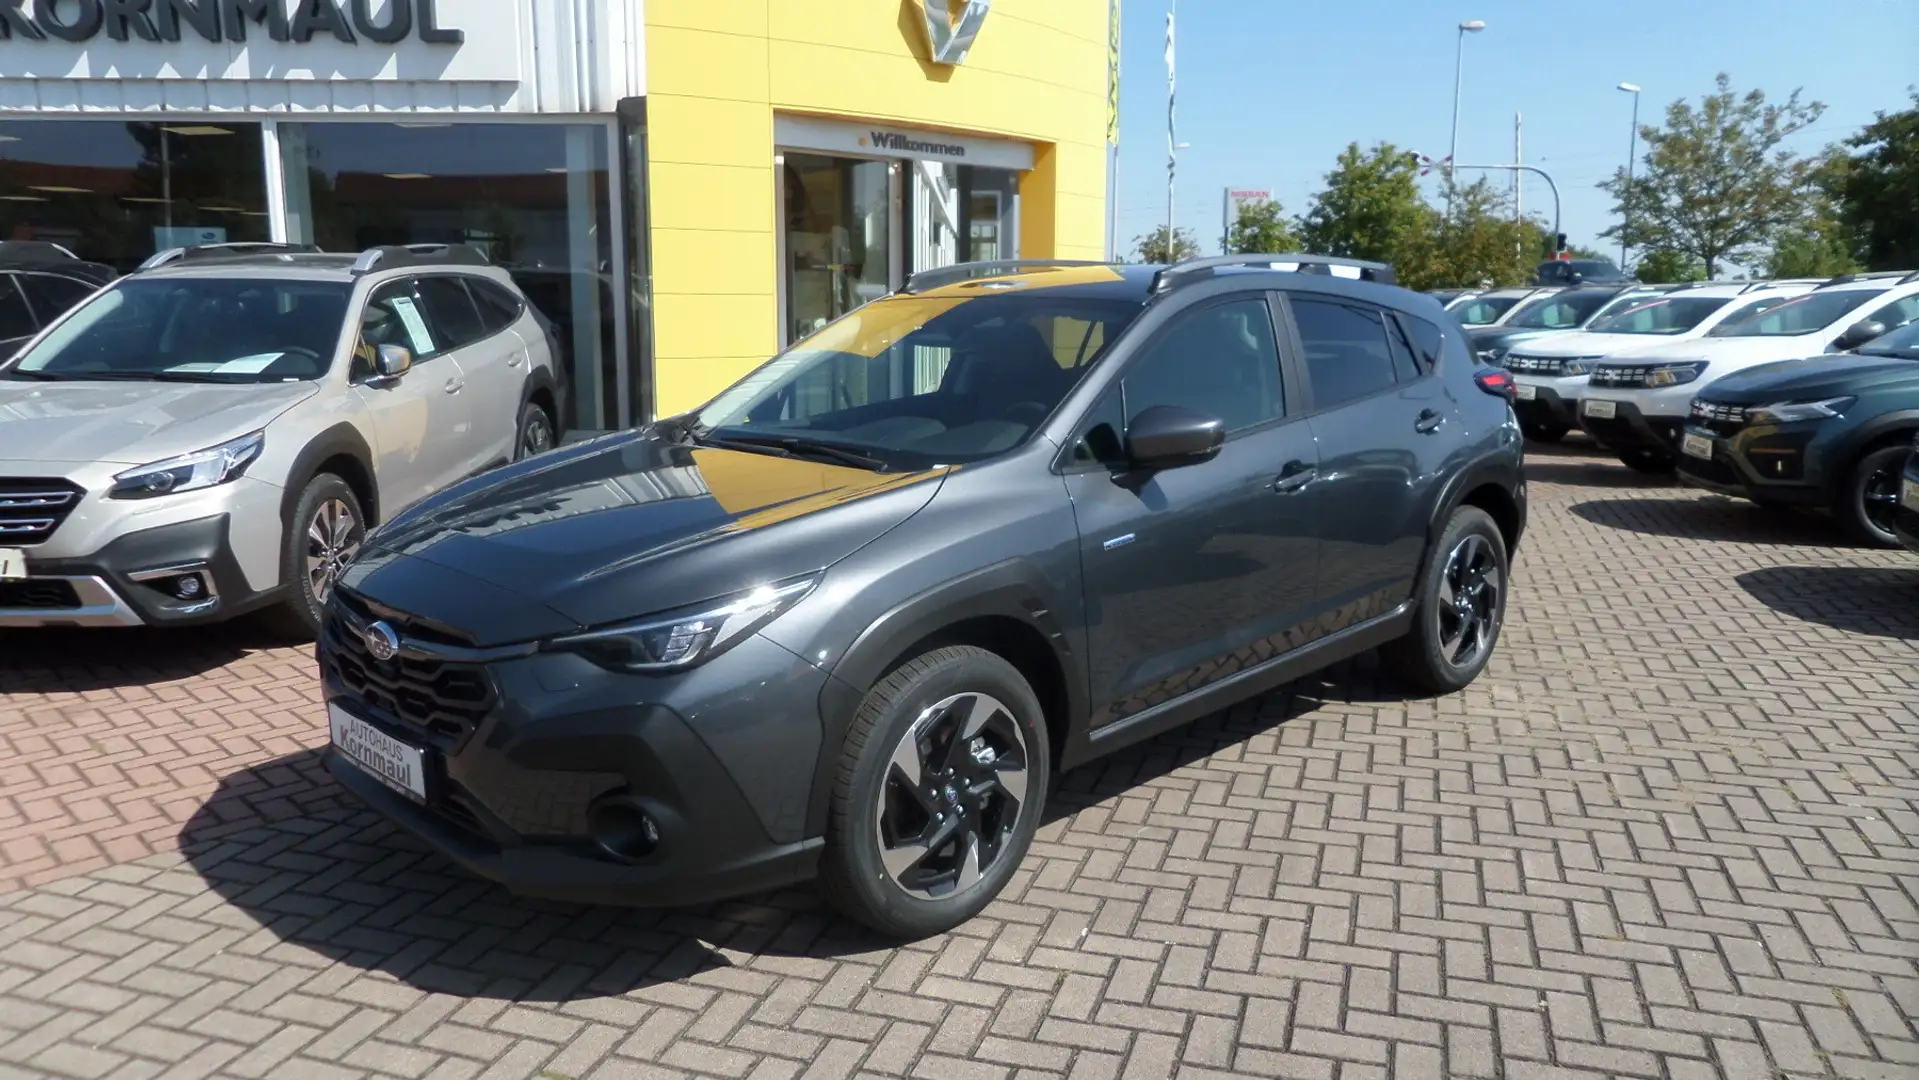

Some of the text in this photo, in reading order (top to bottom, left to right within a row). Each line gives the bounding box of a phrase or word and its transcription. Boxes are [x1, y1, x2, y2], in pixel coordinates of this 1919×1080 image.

[870, 131, 966, 157] Willkommen
[339, 725, 412, 788] Kornmaul
[350, 719, 404, 762] AUTOHAUS
